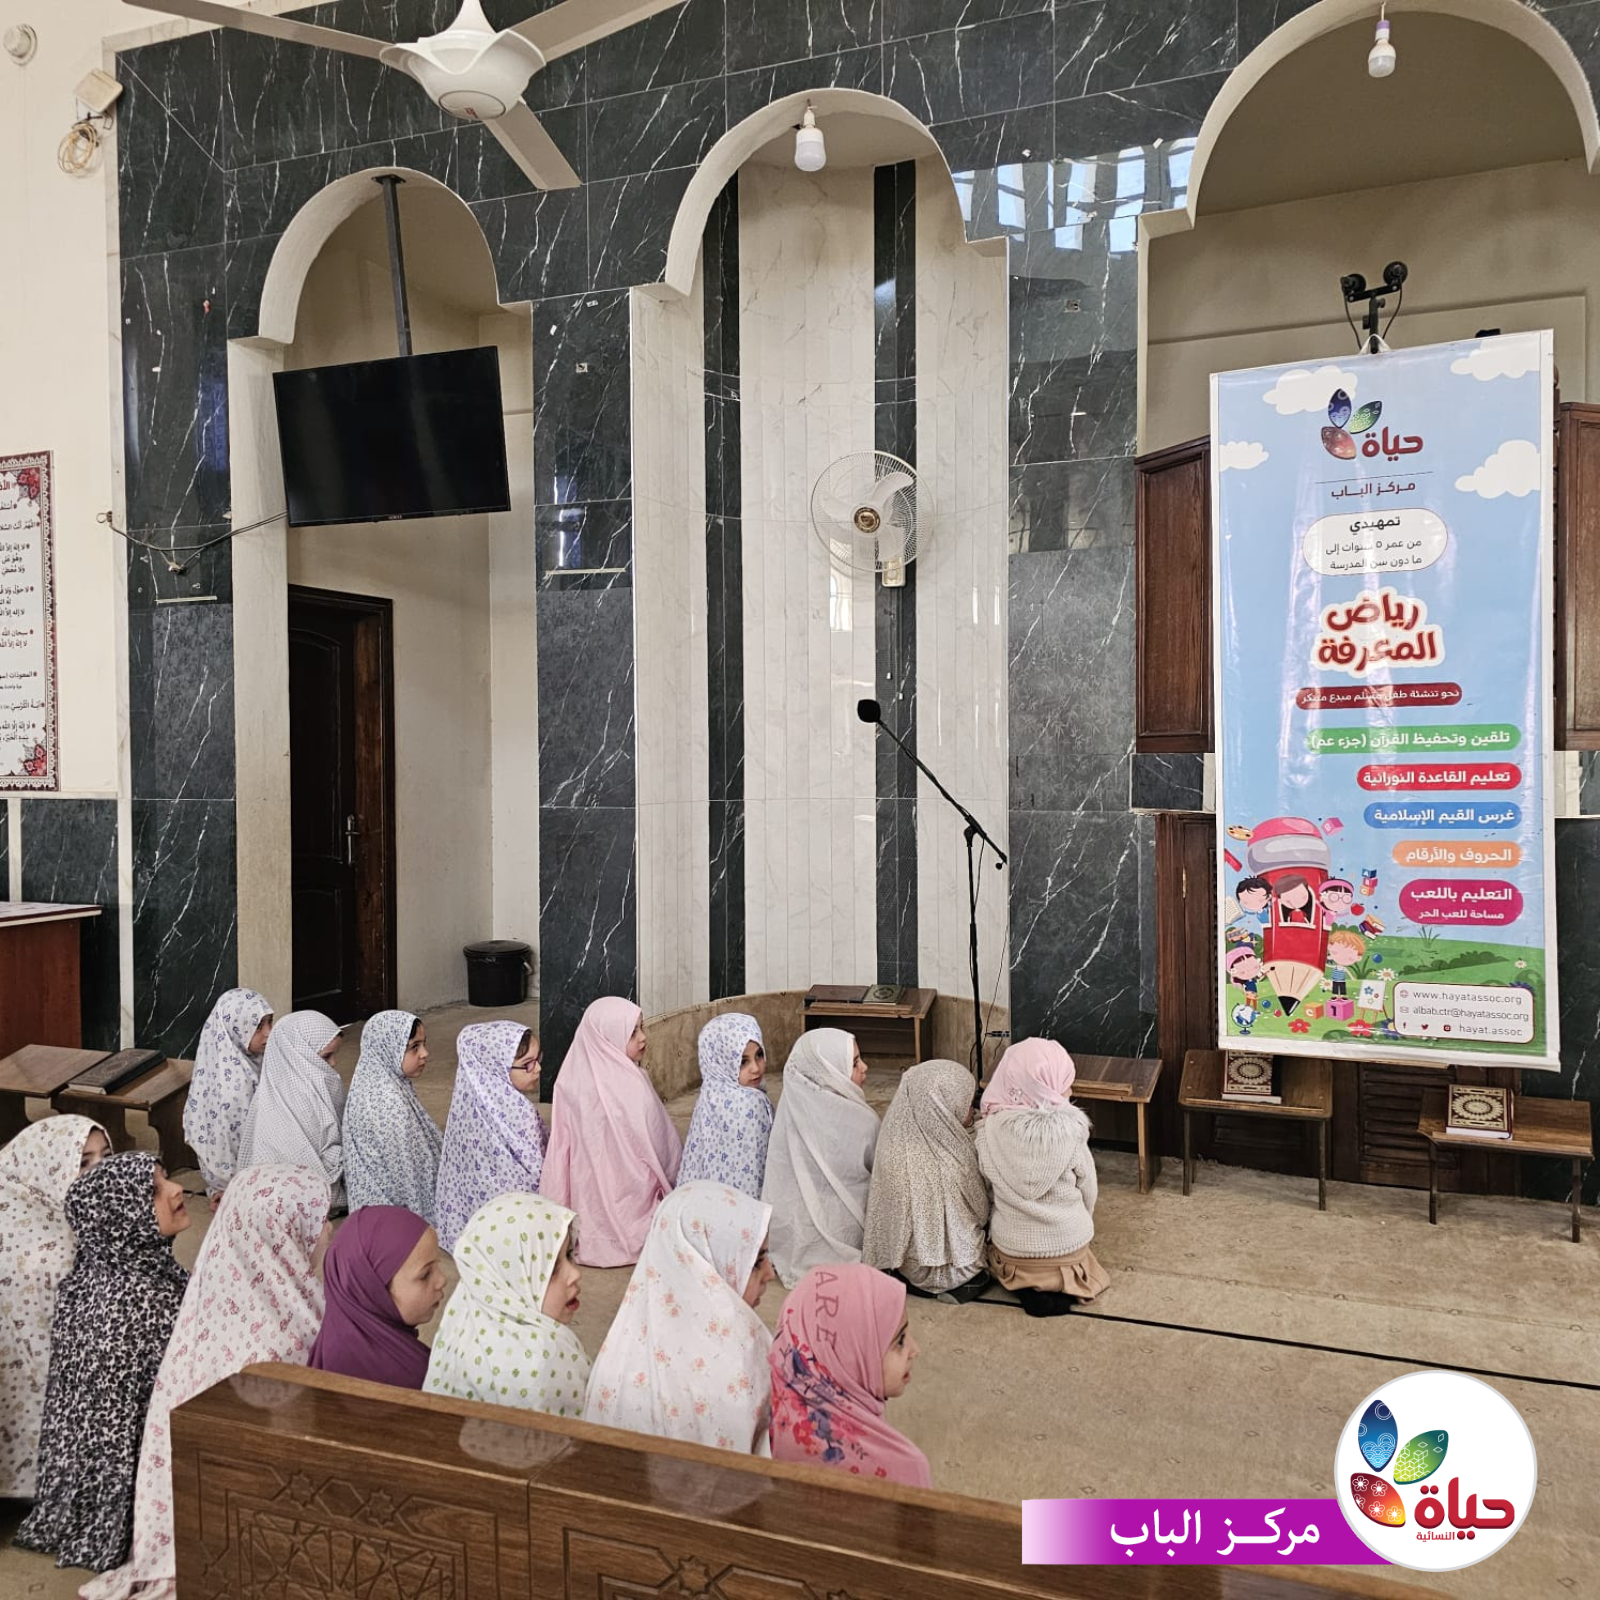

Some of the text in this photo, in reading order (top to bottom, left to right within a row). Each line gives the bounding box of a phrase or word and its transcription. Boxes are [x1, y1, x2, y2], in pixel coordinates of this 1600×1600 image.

[1361, 426, 1424, 461] حياة
[1331, 481, 1416, 500] مركز الباب
[1350, 516, 1401, 535] تمهيدي
[1325, 543, 1340, 556] إلى
[1384, 540, 1404, 551] عمر
[1406, 539, 1422, 550] من
[1369, 559, 1388, 569] سن
[1390, 557, 1410, 567] دون
[1411, 554, 1422, 565] ما
[1326, 593, 1419, 631] رياض
[1318, 631, 1438, 671] المعرفة
[1329, 694, 1352, 704] مبدع
[1410, 690, 1439, 699] تنشئة
[1441, 690, 1460, 700] نحو
[1338, 734, 1367, 749] (جزء
[1370, 732, 1409, 748] القرآن
[1413, 732, 1467, 746] وتحفيظ
[1471, 730, 1510, 747] تلقين
[1363, 770, 1511, 786] تعليم القاعدة النورانية
[1374, 809, 1515, 825] غرس القيم الإسلامية
[1406, 847, 1512, 864] الحروف والأرقام
[1411, 887, 1513, 902] التعليم باللعب
[1418, 908, 1505, 920] مساحة للعب الحر
[1413, 990, 1522, 1005] www.hayatassoc.org
[1412, 1006, 1529, 1022] albab.ctr@hayatassoc.org
[1459, 1023, 1523, 1036] hayat.assoc
